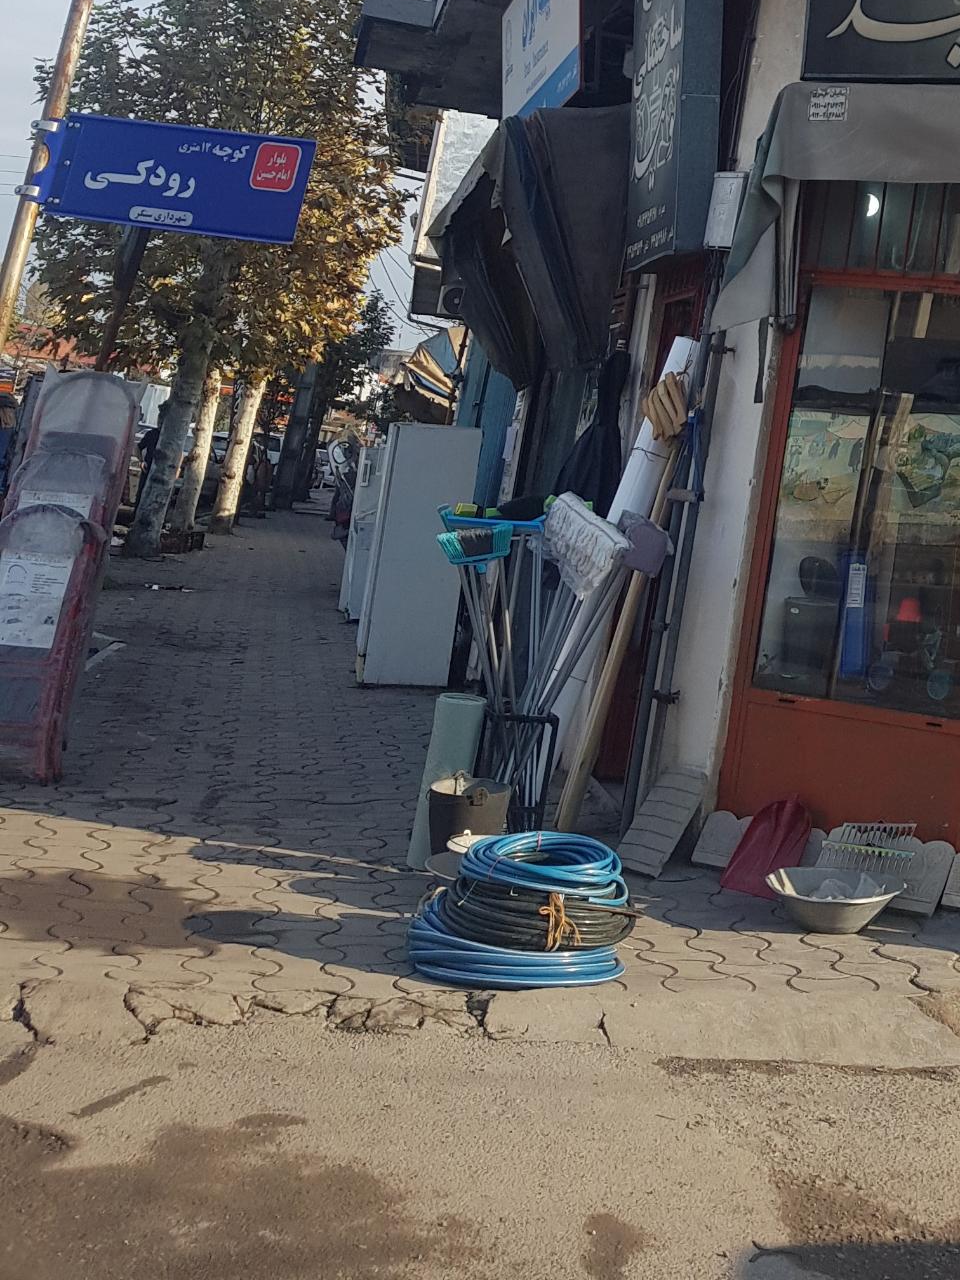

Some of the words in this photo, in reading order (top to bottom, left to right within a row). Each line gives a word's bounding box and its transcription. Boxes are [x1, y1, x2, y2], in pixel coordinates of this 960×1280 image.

[178, 142, 200, 154] متری
[212, 144, 250, 162] کوچه
[267, 152, 287, 166] بلوار
[84, 159, 196, 199] رودکی
